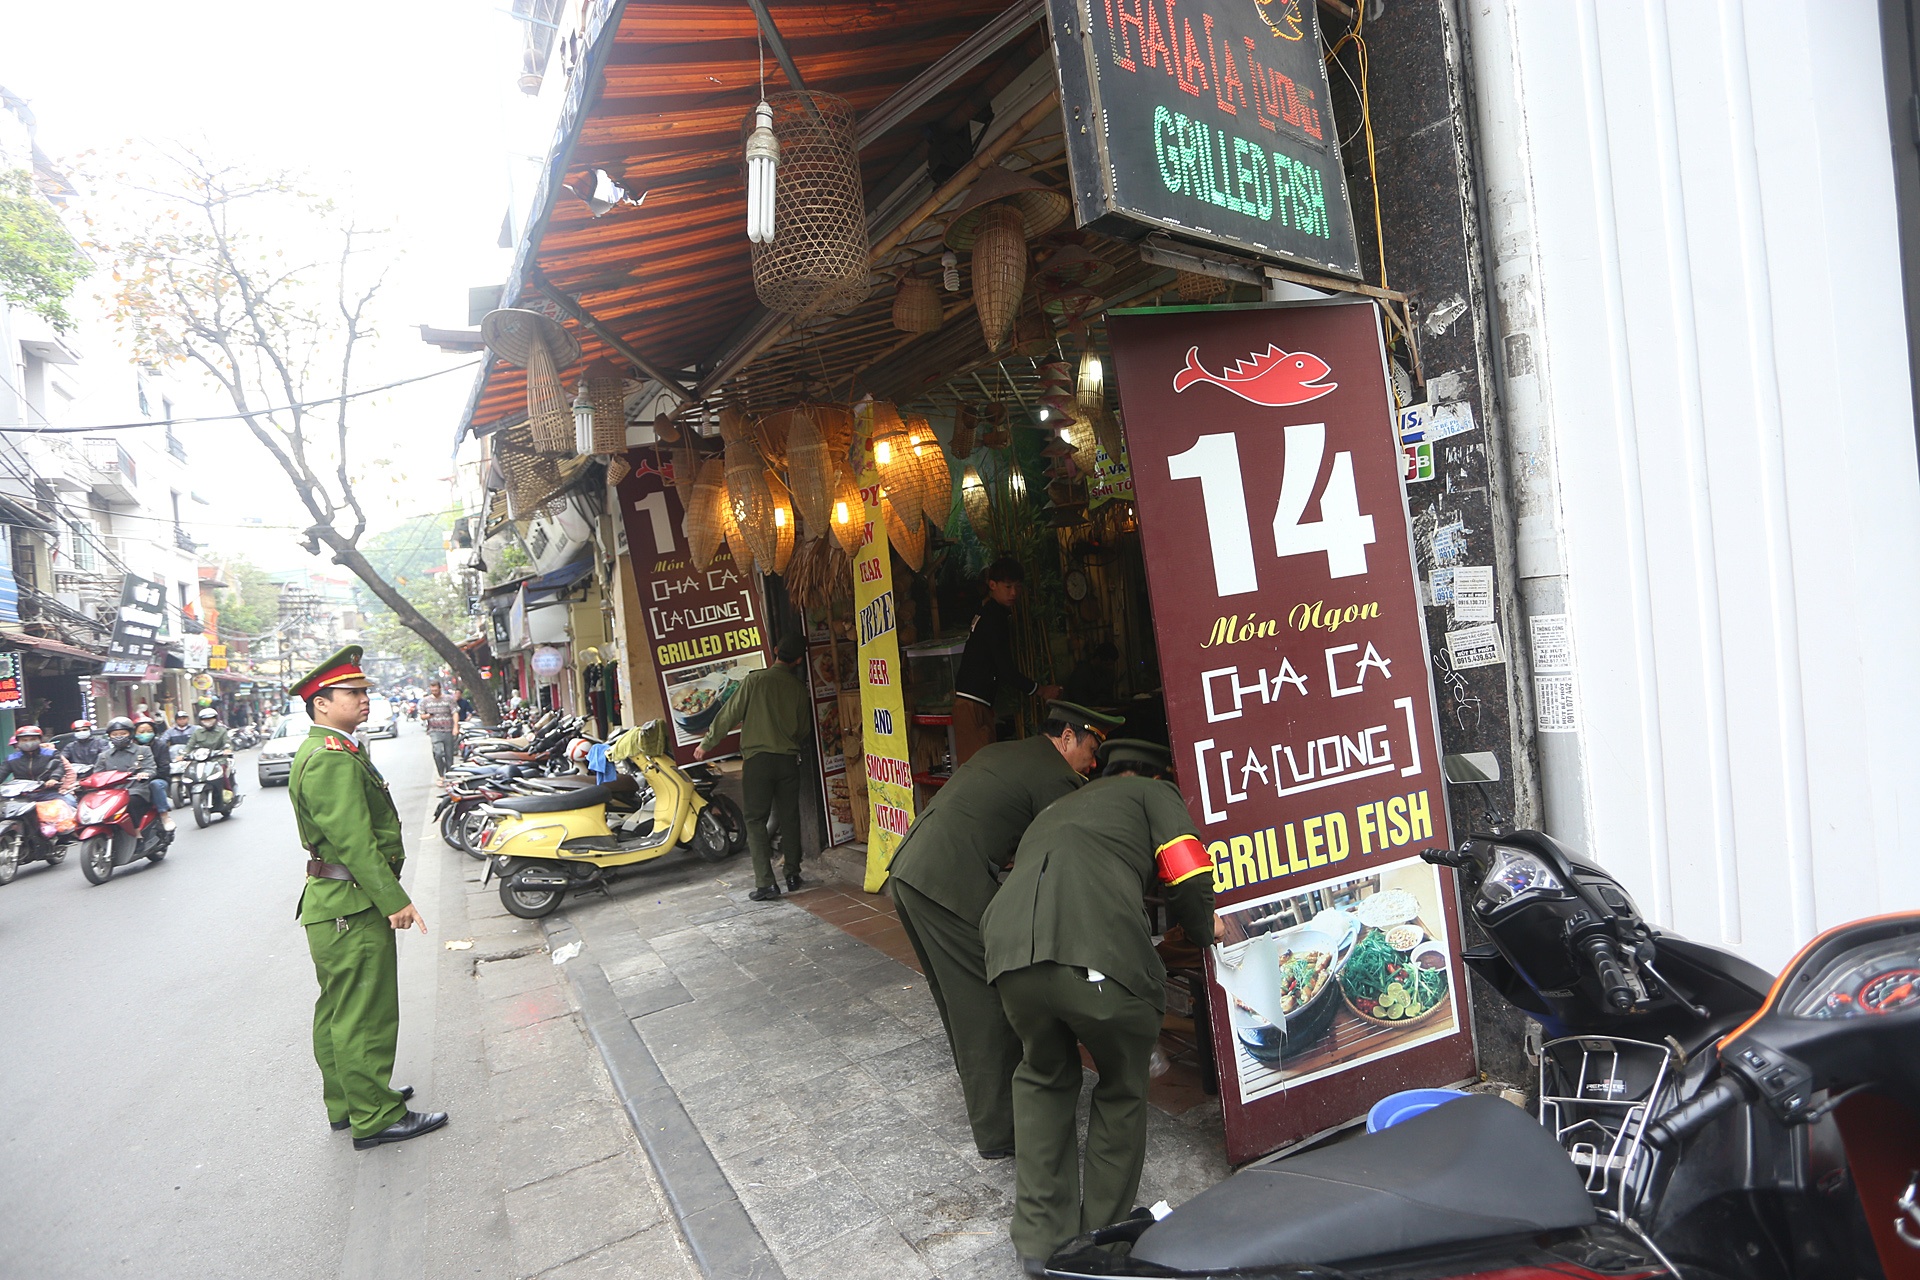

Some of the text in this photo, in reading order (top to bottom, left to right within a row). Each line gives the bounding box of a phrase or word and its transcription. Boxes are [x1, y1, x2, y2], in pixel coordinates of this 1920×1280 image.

[1154, 106, 1331, 239] GRILLED FISH
[1167, 422, 1377, 597] 14
[651, 558, 684, 575] Món
[651, 568, 738, 602] CHA CA
[860, 591, 895, 647] FREE
[1200, 600, 1381, 649] Món Ngon
[657, 626, 761, 666] GRILLED FISH
[869, 658, 889, 685] BEER
[1201, 656, 1308, 723] CHA
[1324, 640, 1392, 698] CA
[873, 708, 893, 735] AND
[866, 753, 911, 789] SMOOTHIES
[1206, 789, 1433, 893] GRILLED FISH
